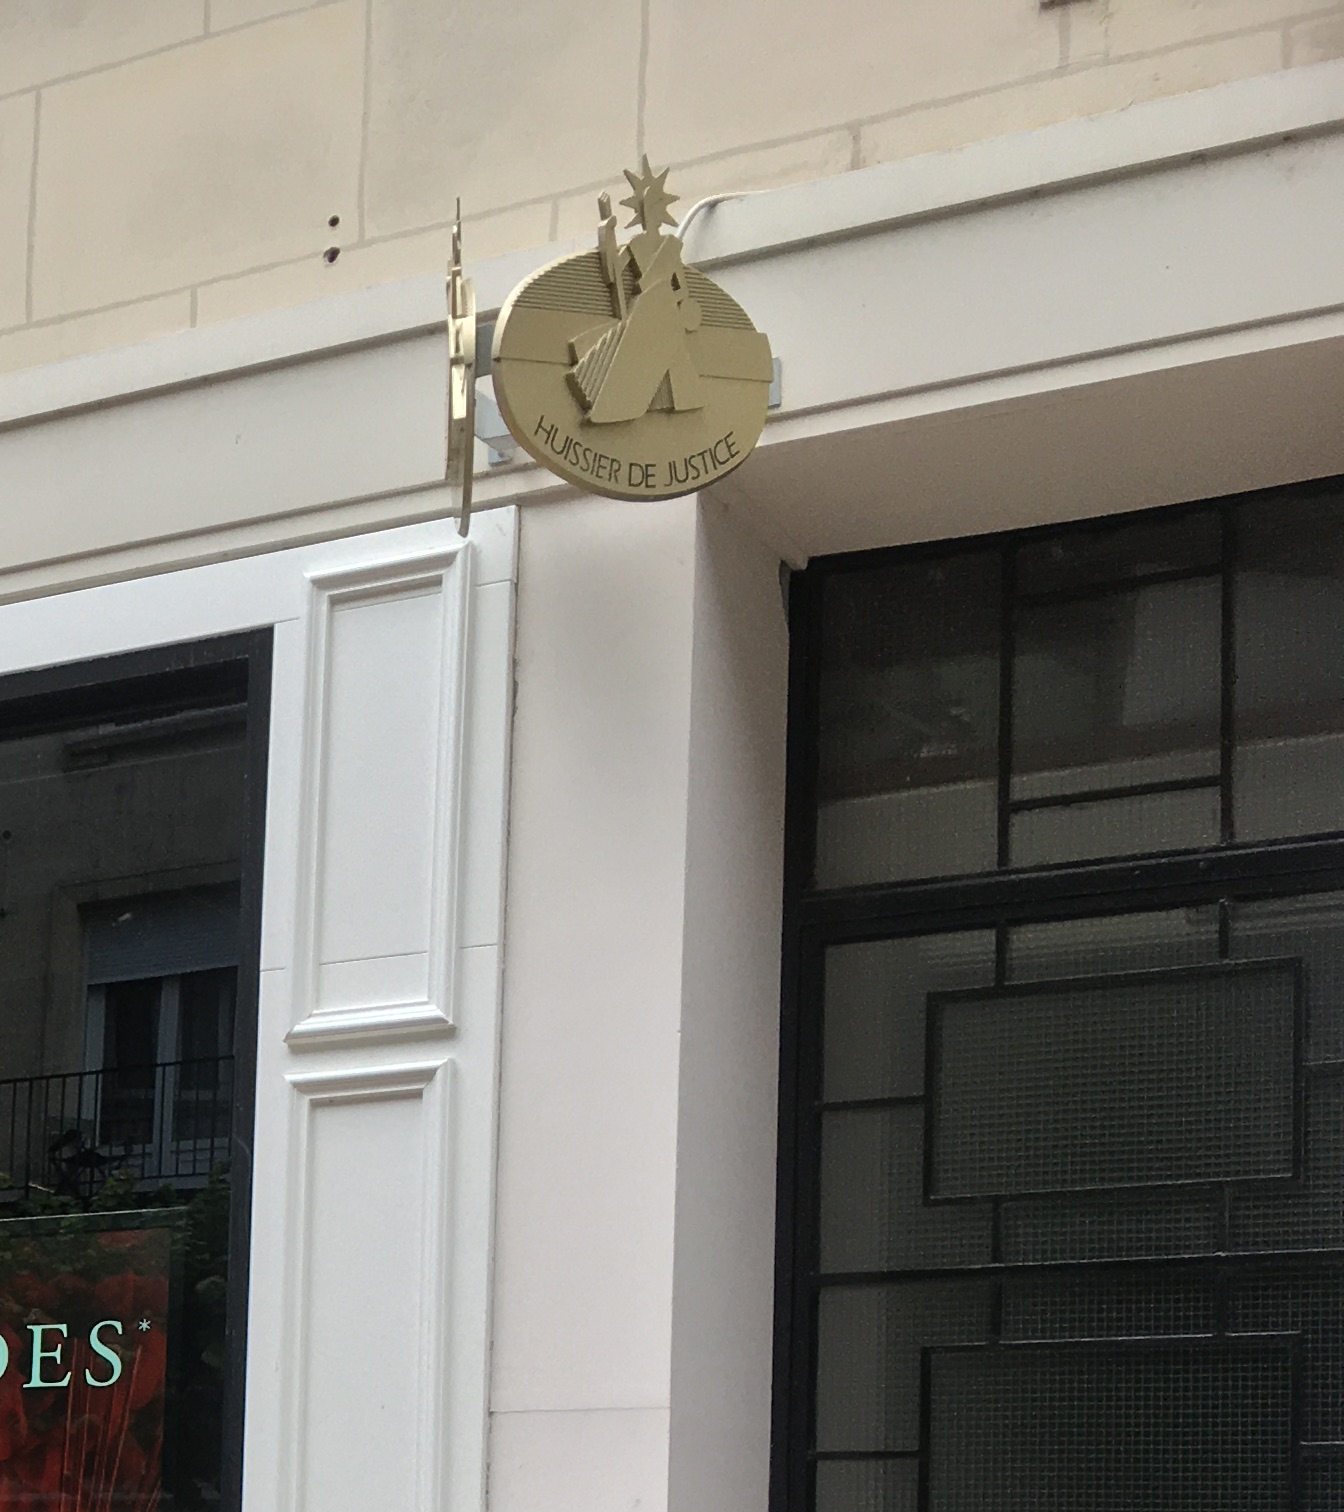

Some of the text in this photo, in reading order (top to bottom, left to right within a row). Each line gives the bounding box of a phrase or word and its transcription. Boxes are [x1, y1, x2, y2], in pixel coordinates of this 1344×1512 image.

[534, 415, 740, 488] HUISSIER DE JUSTICE
